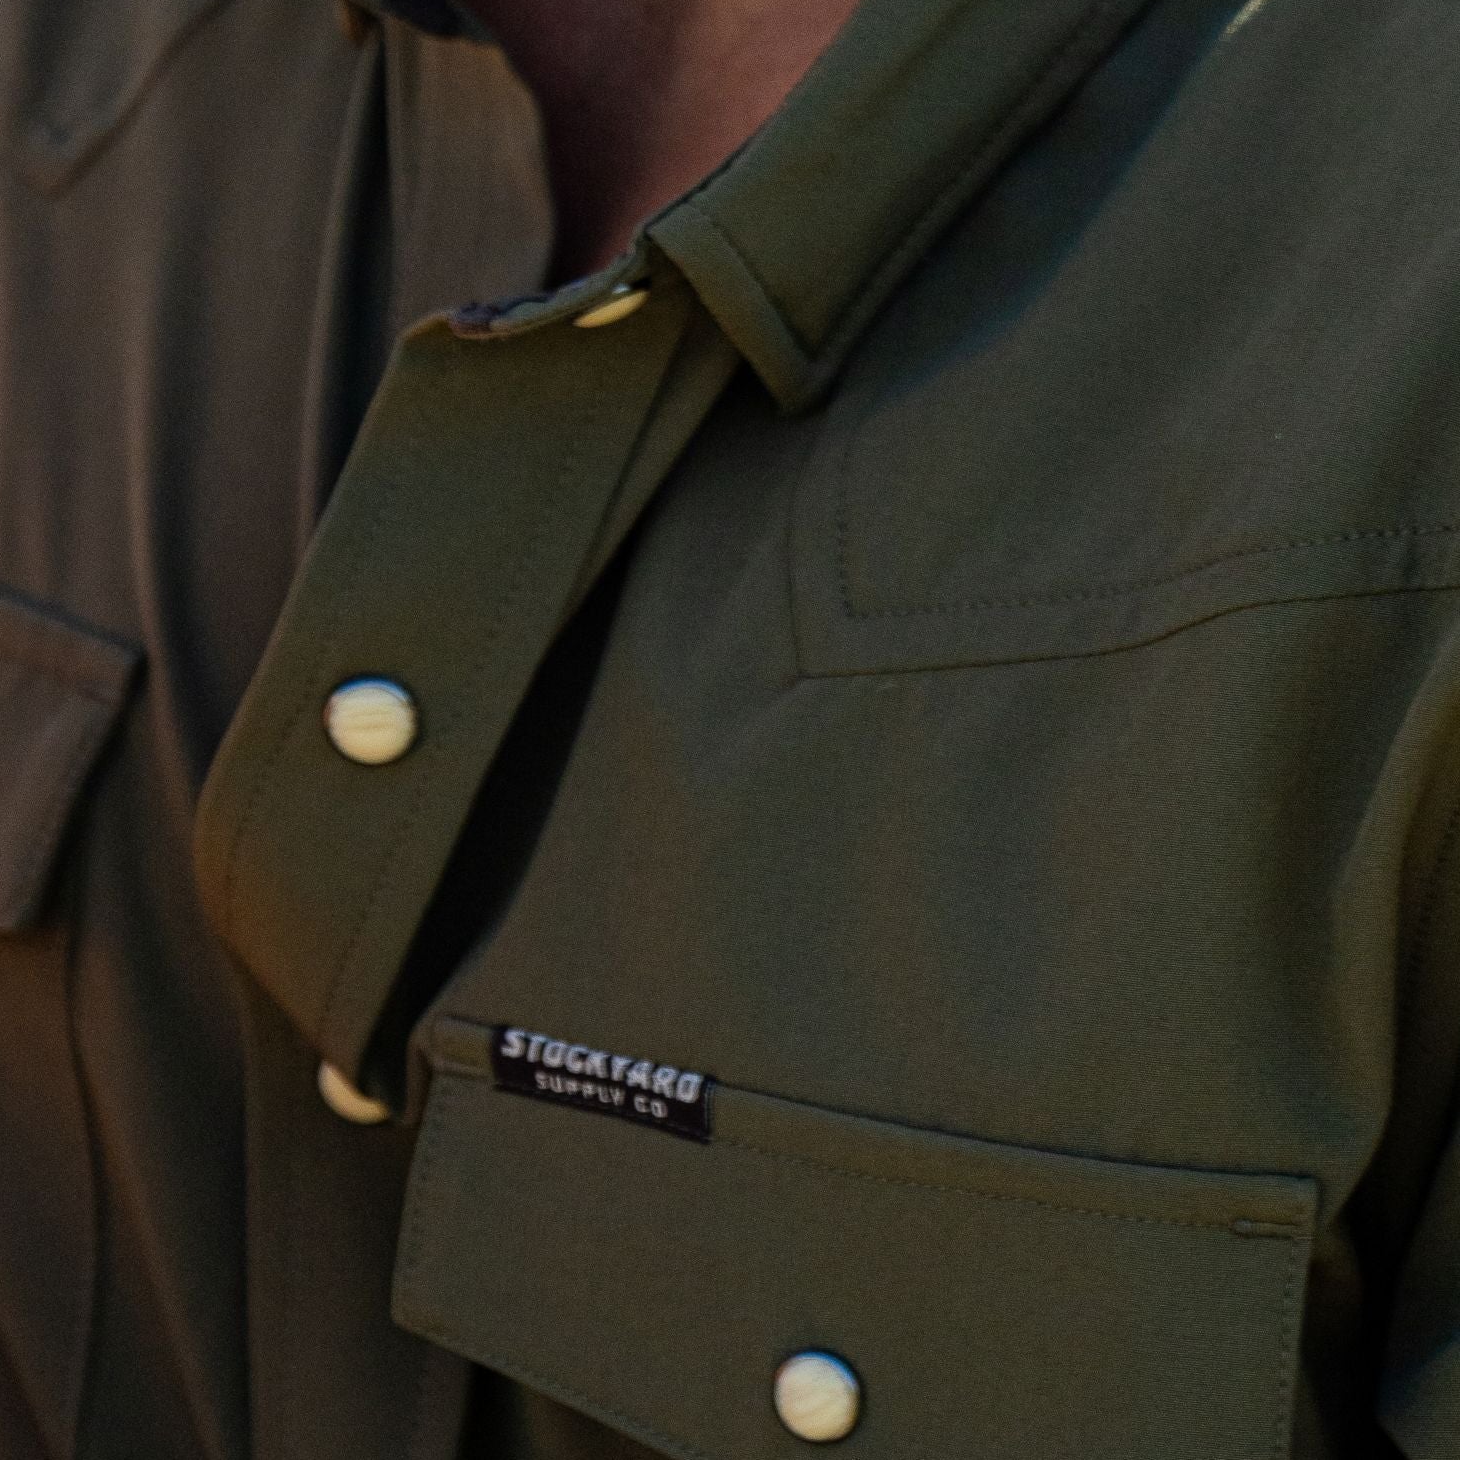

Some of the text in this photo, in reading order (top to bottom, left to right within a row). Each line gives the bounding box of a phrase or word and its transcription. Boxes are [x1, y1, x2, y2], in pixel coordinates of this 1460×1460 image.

[500, 1028, 706, 1104] STOCKYARD
[535, 1070, 669, 1119] SUPPLY CO
